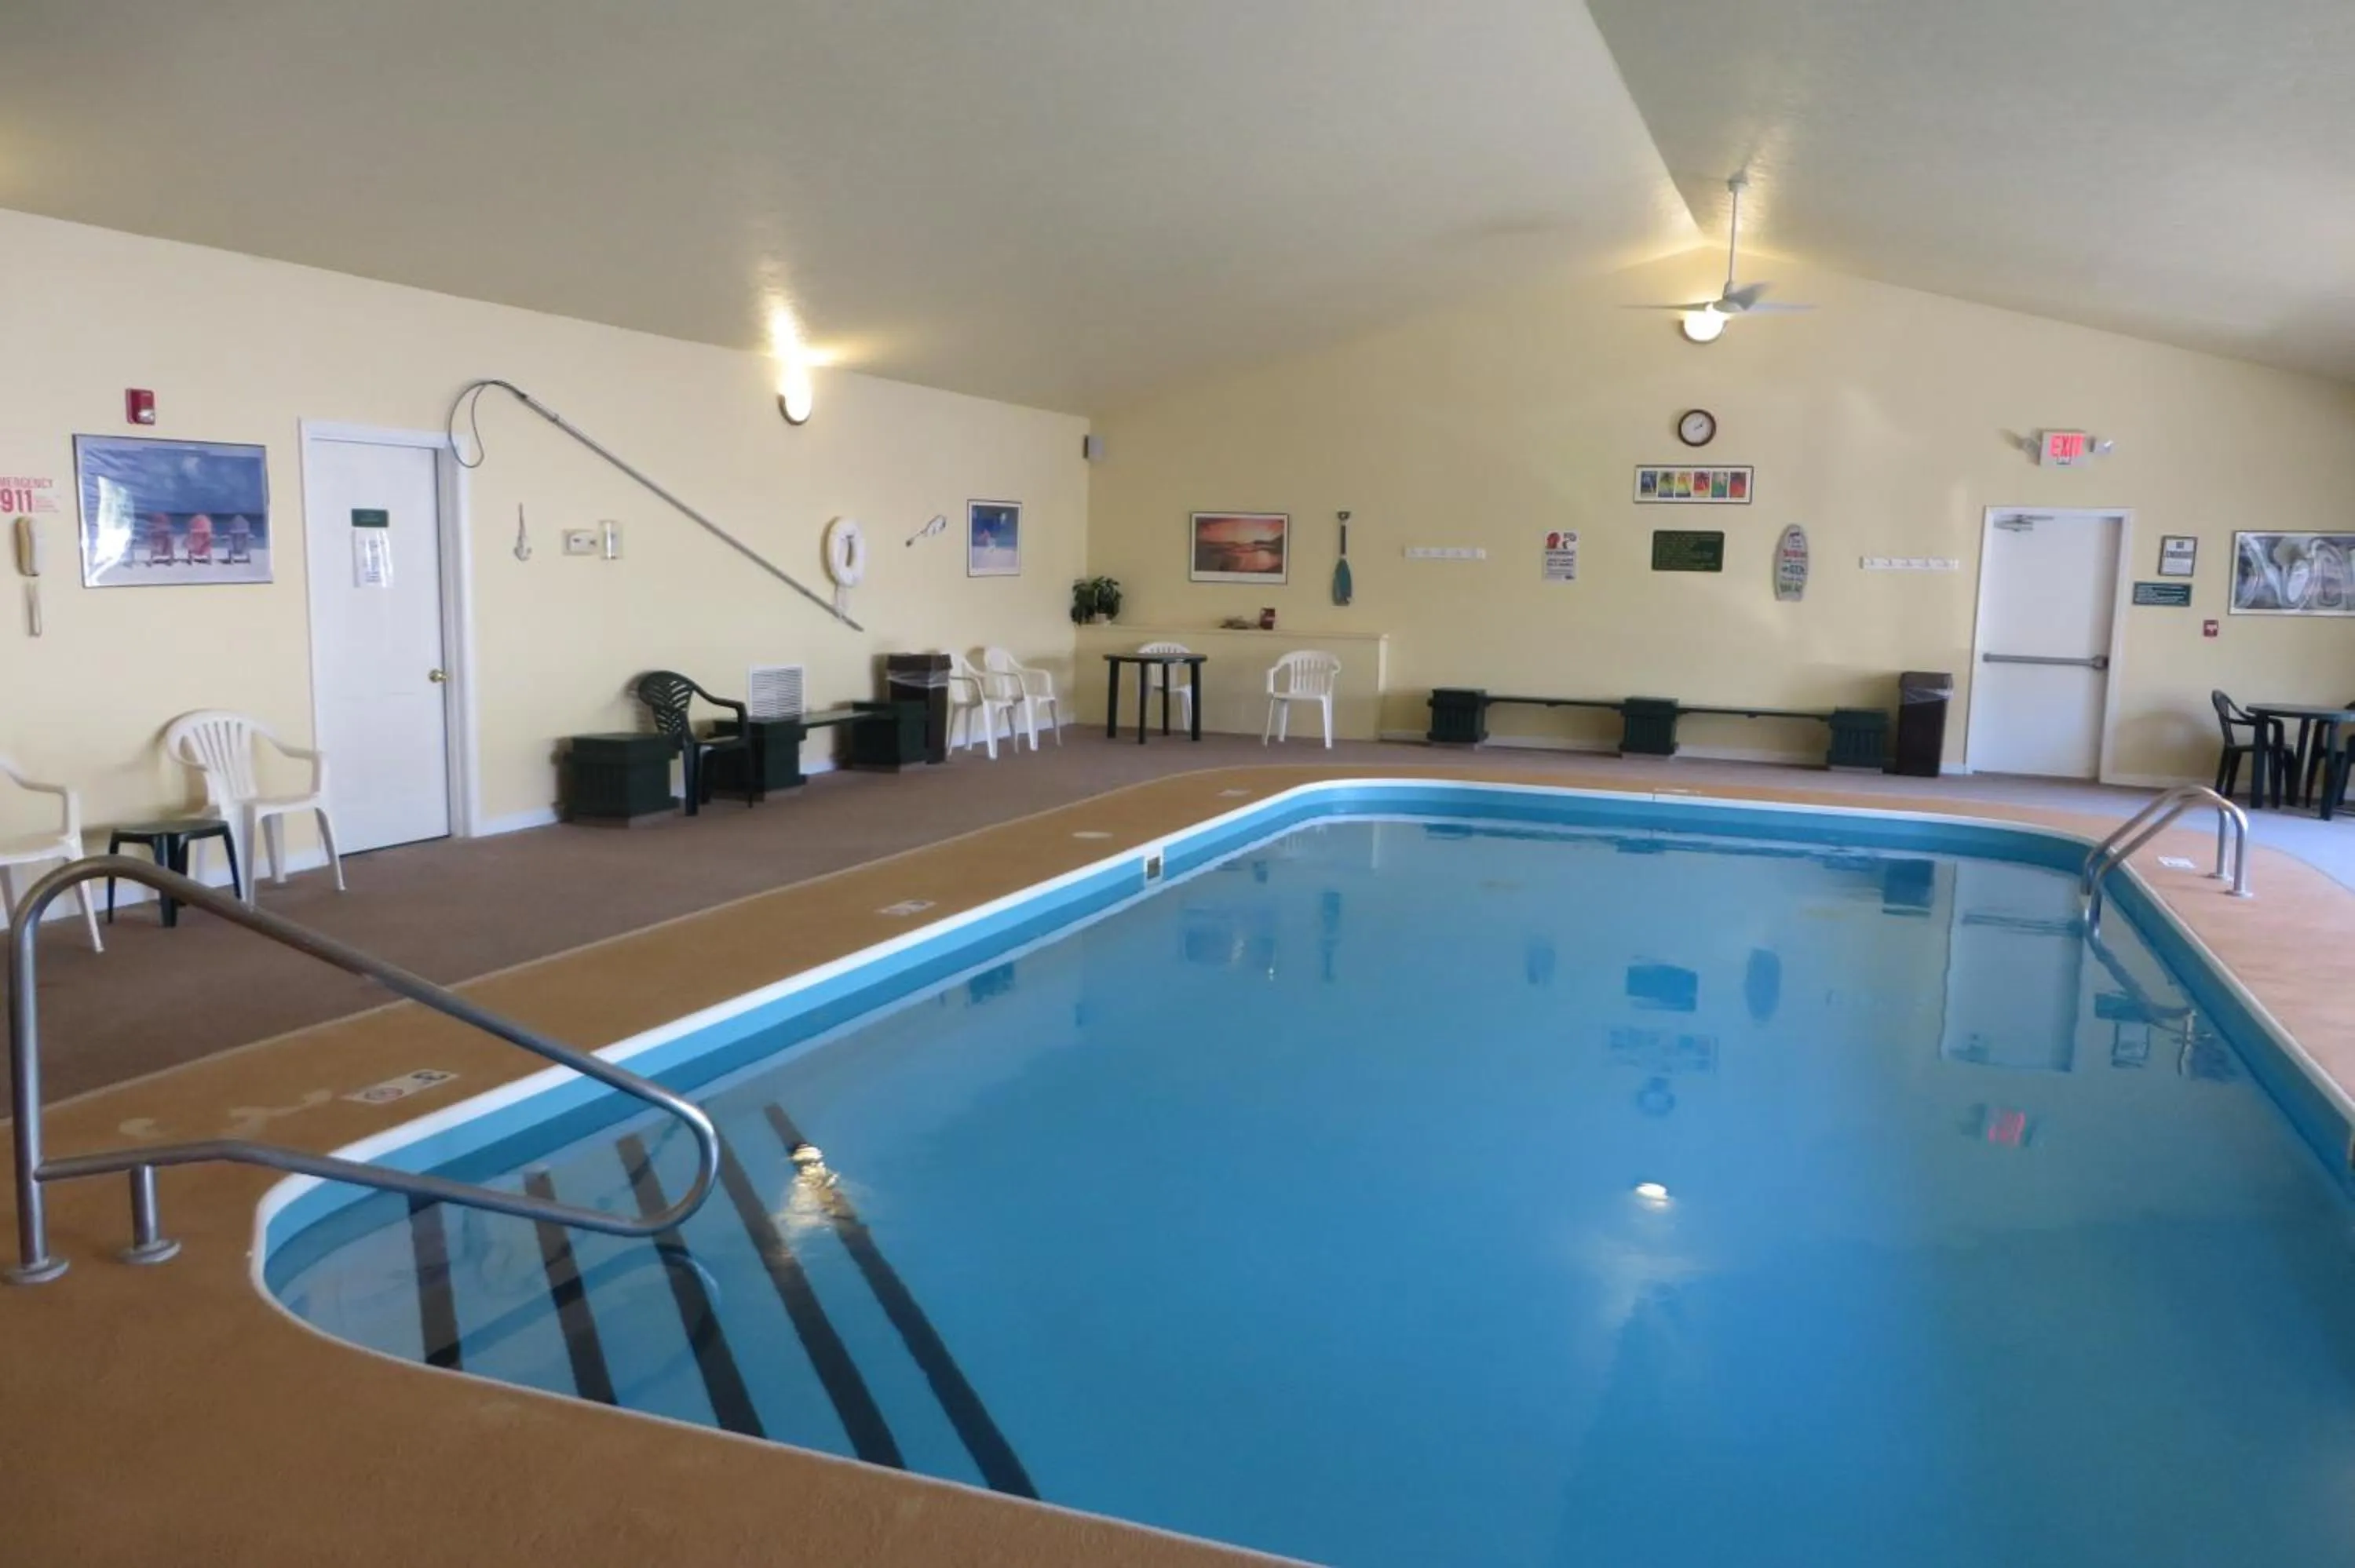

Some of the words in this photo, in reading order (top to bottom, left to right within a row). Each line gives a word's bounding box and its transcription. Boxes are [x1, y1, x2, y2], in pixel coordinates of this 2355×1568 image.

[2050, 435, 2085, 457] EXIT
[0, 476, 53, 488] MERGENCY
[0, 488, 32, 513] 911
